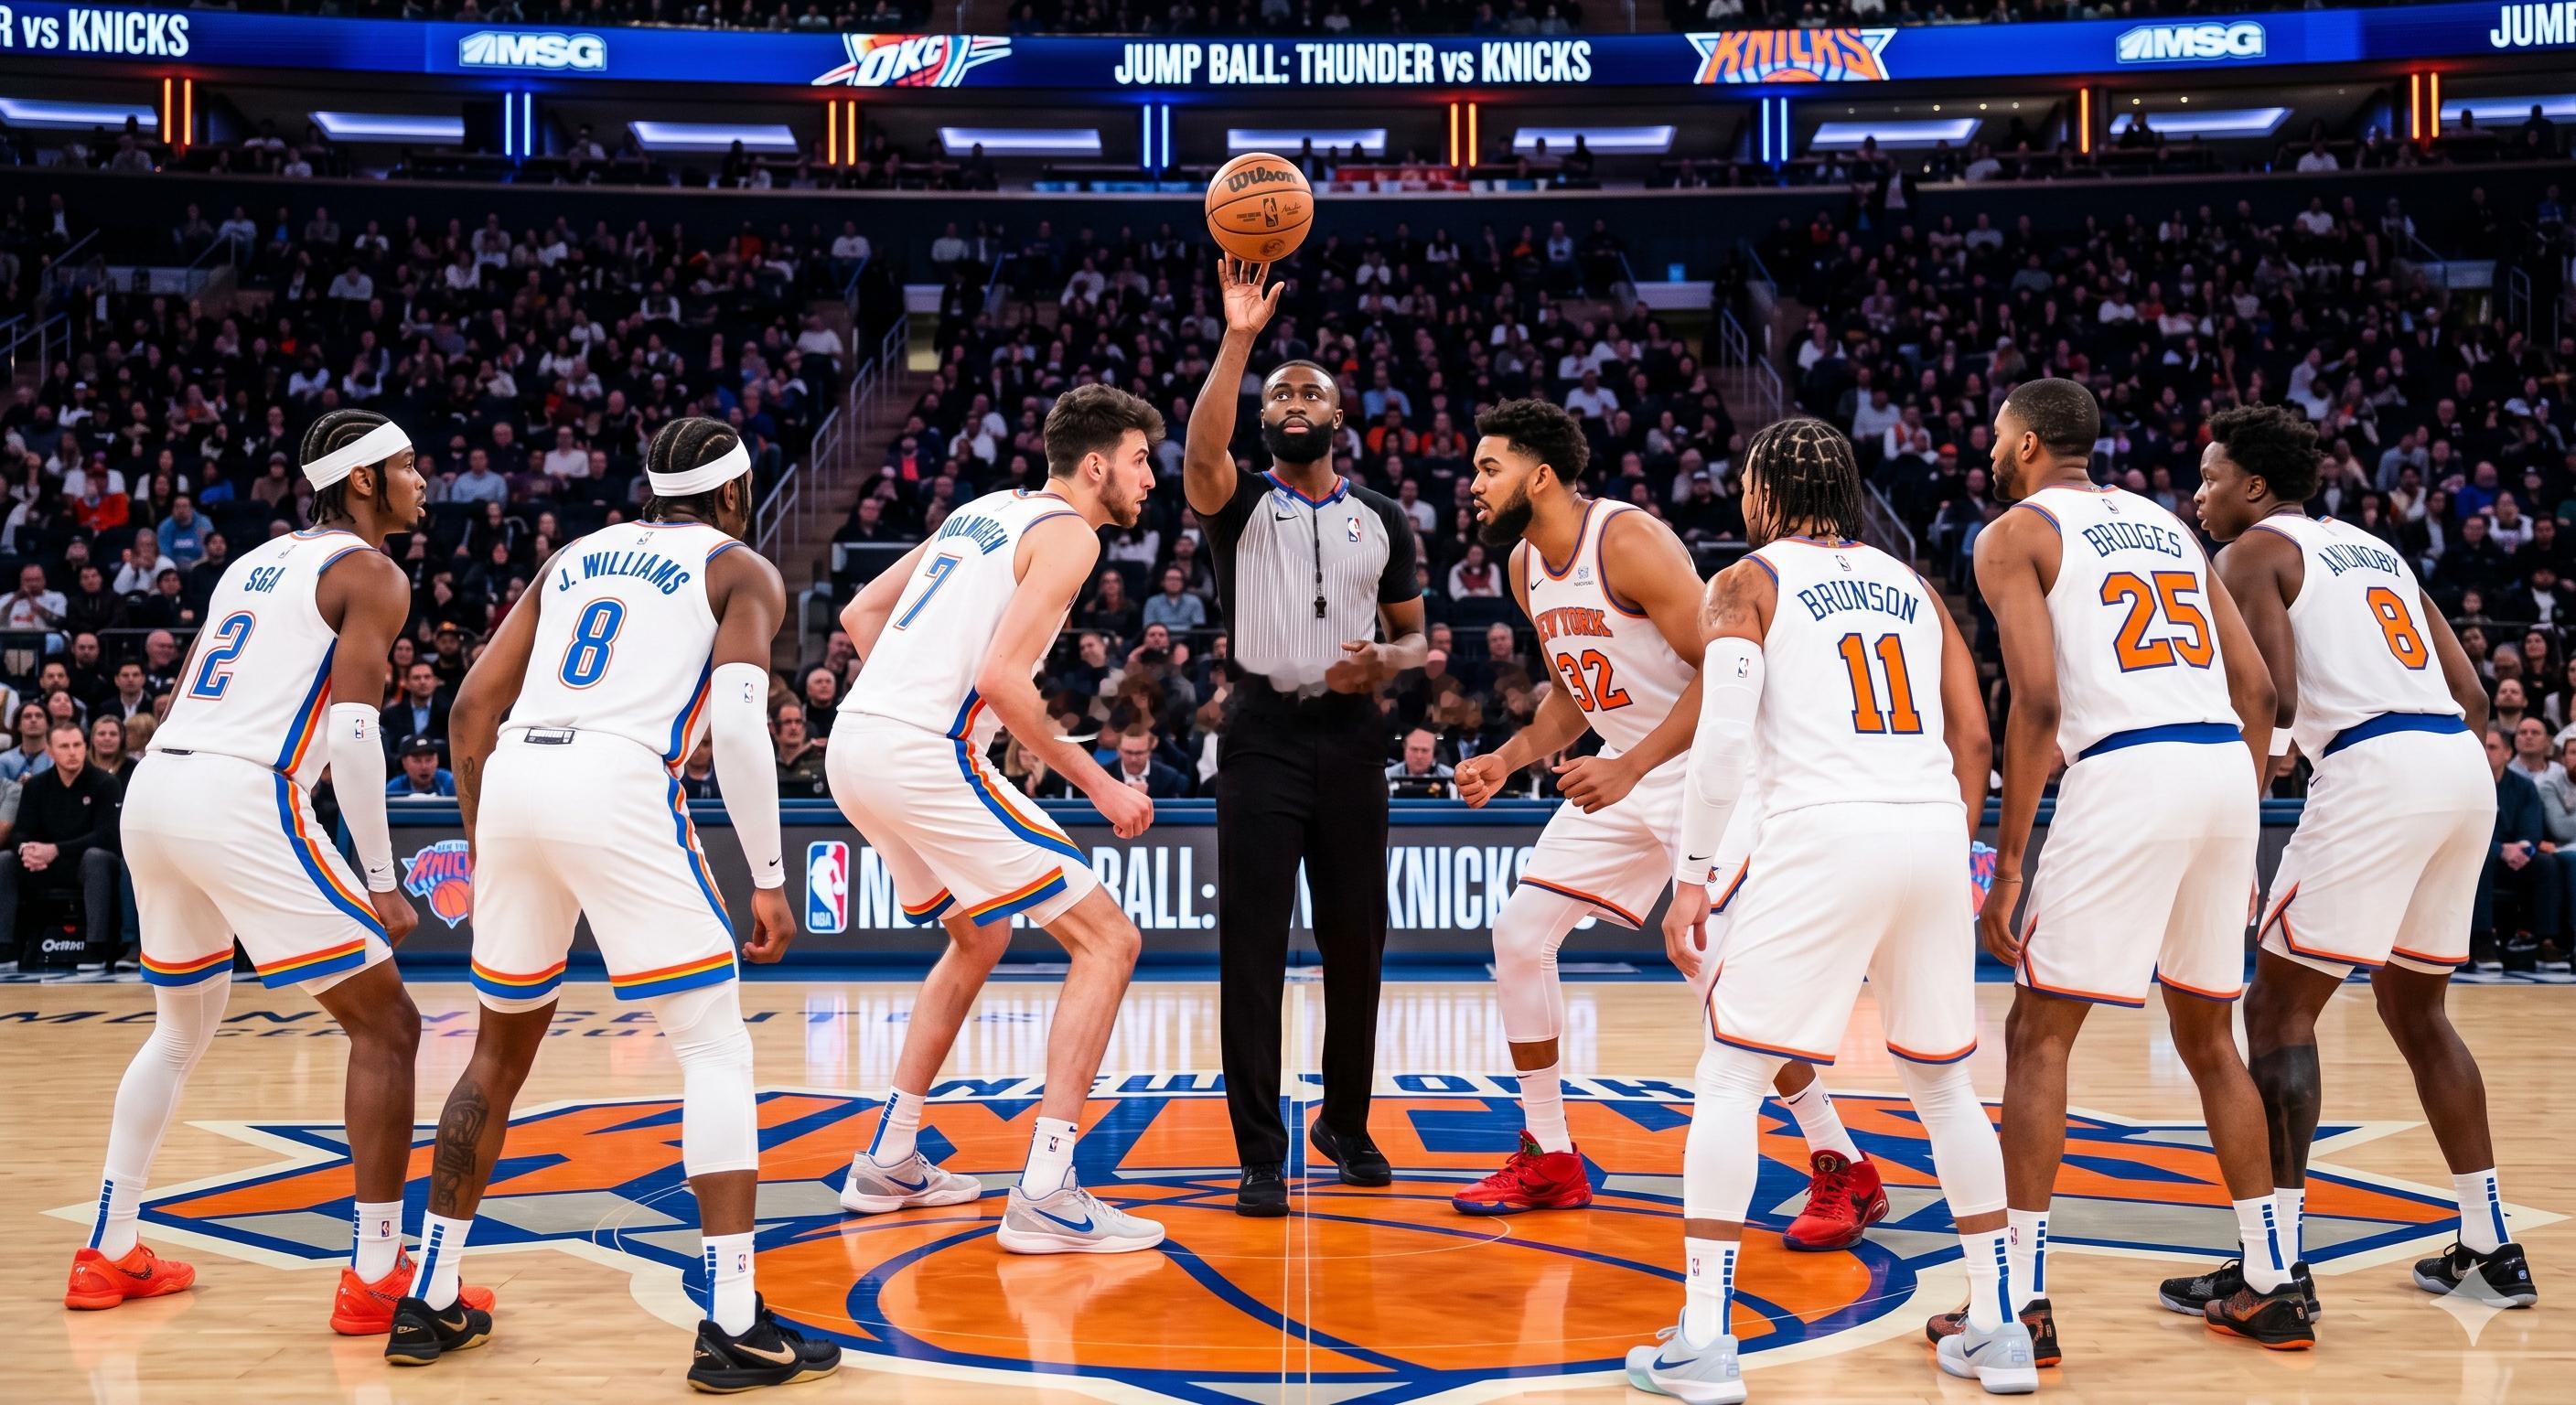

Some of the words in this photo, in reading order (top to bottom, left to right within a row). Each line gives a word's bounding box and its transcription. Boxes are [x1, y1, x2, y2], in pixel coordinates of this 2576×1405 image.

[22, 16, 59, 48] vs
[69, 9, 189, 57] KNICKS
[497, 34, 604, 69] MSG
[2153, 24, 2262, 59] MSG
[853, 35, 946, 87] OKC
[1114, 43, 1202, 85] JUMP
[1208, 43, 1290, 84] BALL:
[1295, 42, 1434, 84] THUNDER
[1440, 51, 1474, 83] vs
[1481, 40, 1592, 82] KNICKS
[1701, 28, 1883, 83] KNICKS
[1227, 166, 1297, 192] Wilson
[937, 515, 1008, 555] HOLMGREN
[2082, 522, 2182, 558] BRIDGES
[244, 567, 285, 593] SGA
[559, 568, 576, 592] J.
[583, 552, 691, 595] WILLIAMS
[2318, 544, 2400, 577] ANUNOBY
[893, 552, 962, 630] 7
[1797, 580, 1918, 624] BRUNSON
[558, 596, 627, 690] 8
[1557, 606, 1614, 638] YORK
[2099, 571, 2215, 673] 25
[2366, 586, 2430, 670] 8
[187, 610, 256, 701] 2
[1557, 649, 1633, 712] 32
[1837, 633, 1924, 735] 11
[811, 911, 832, 928] NBA
